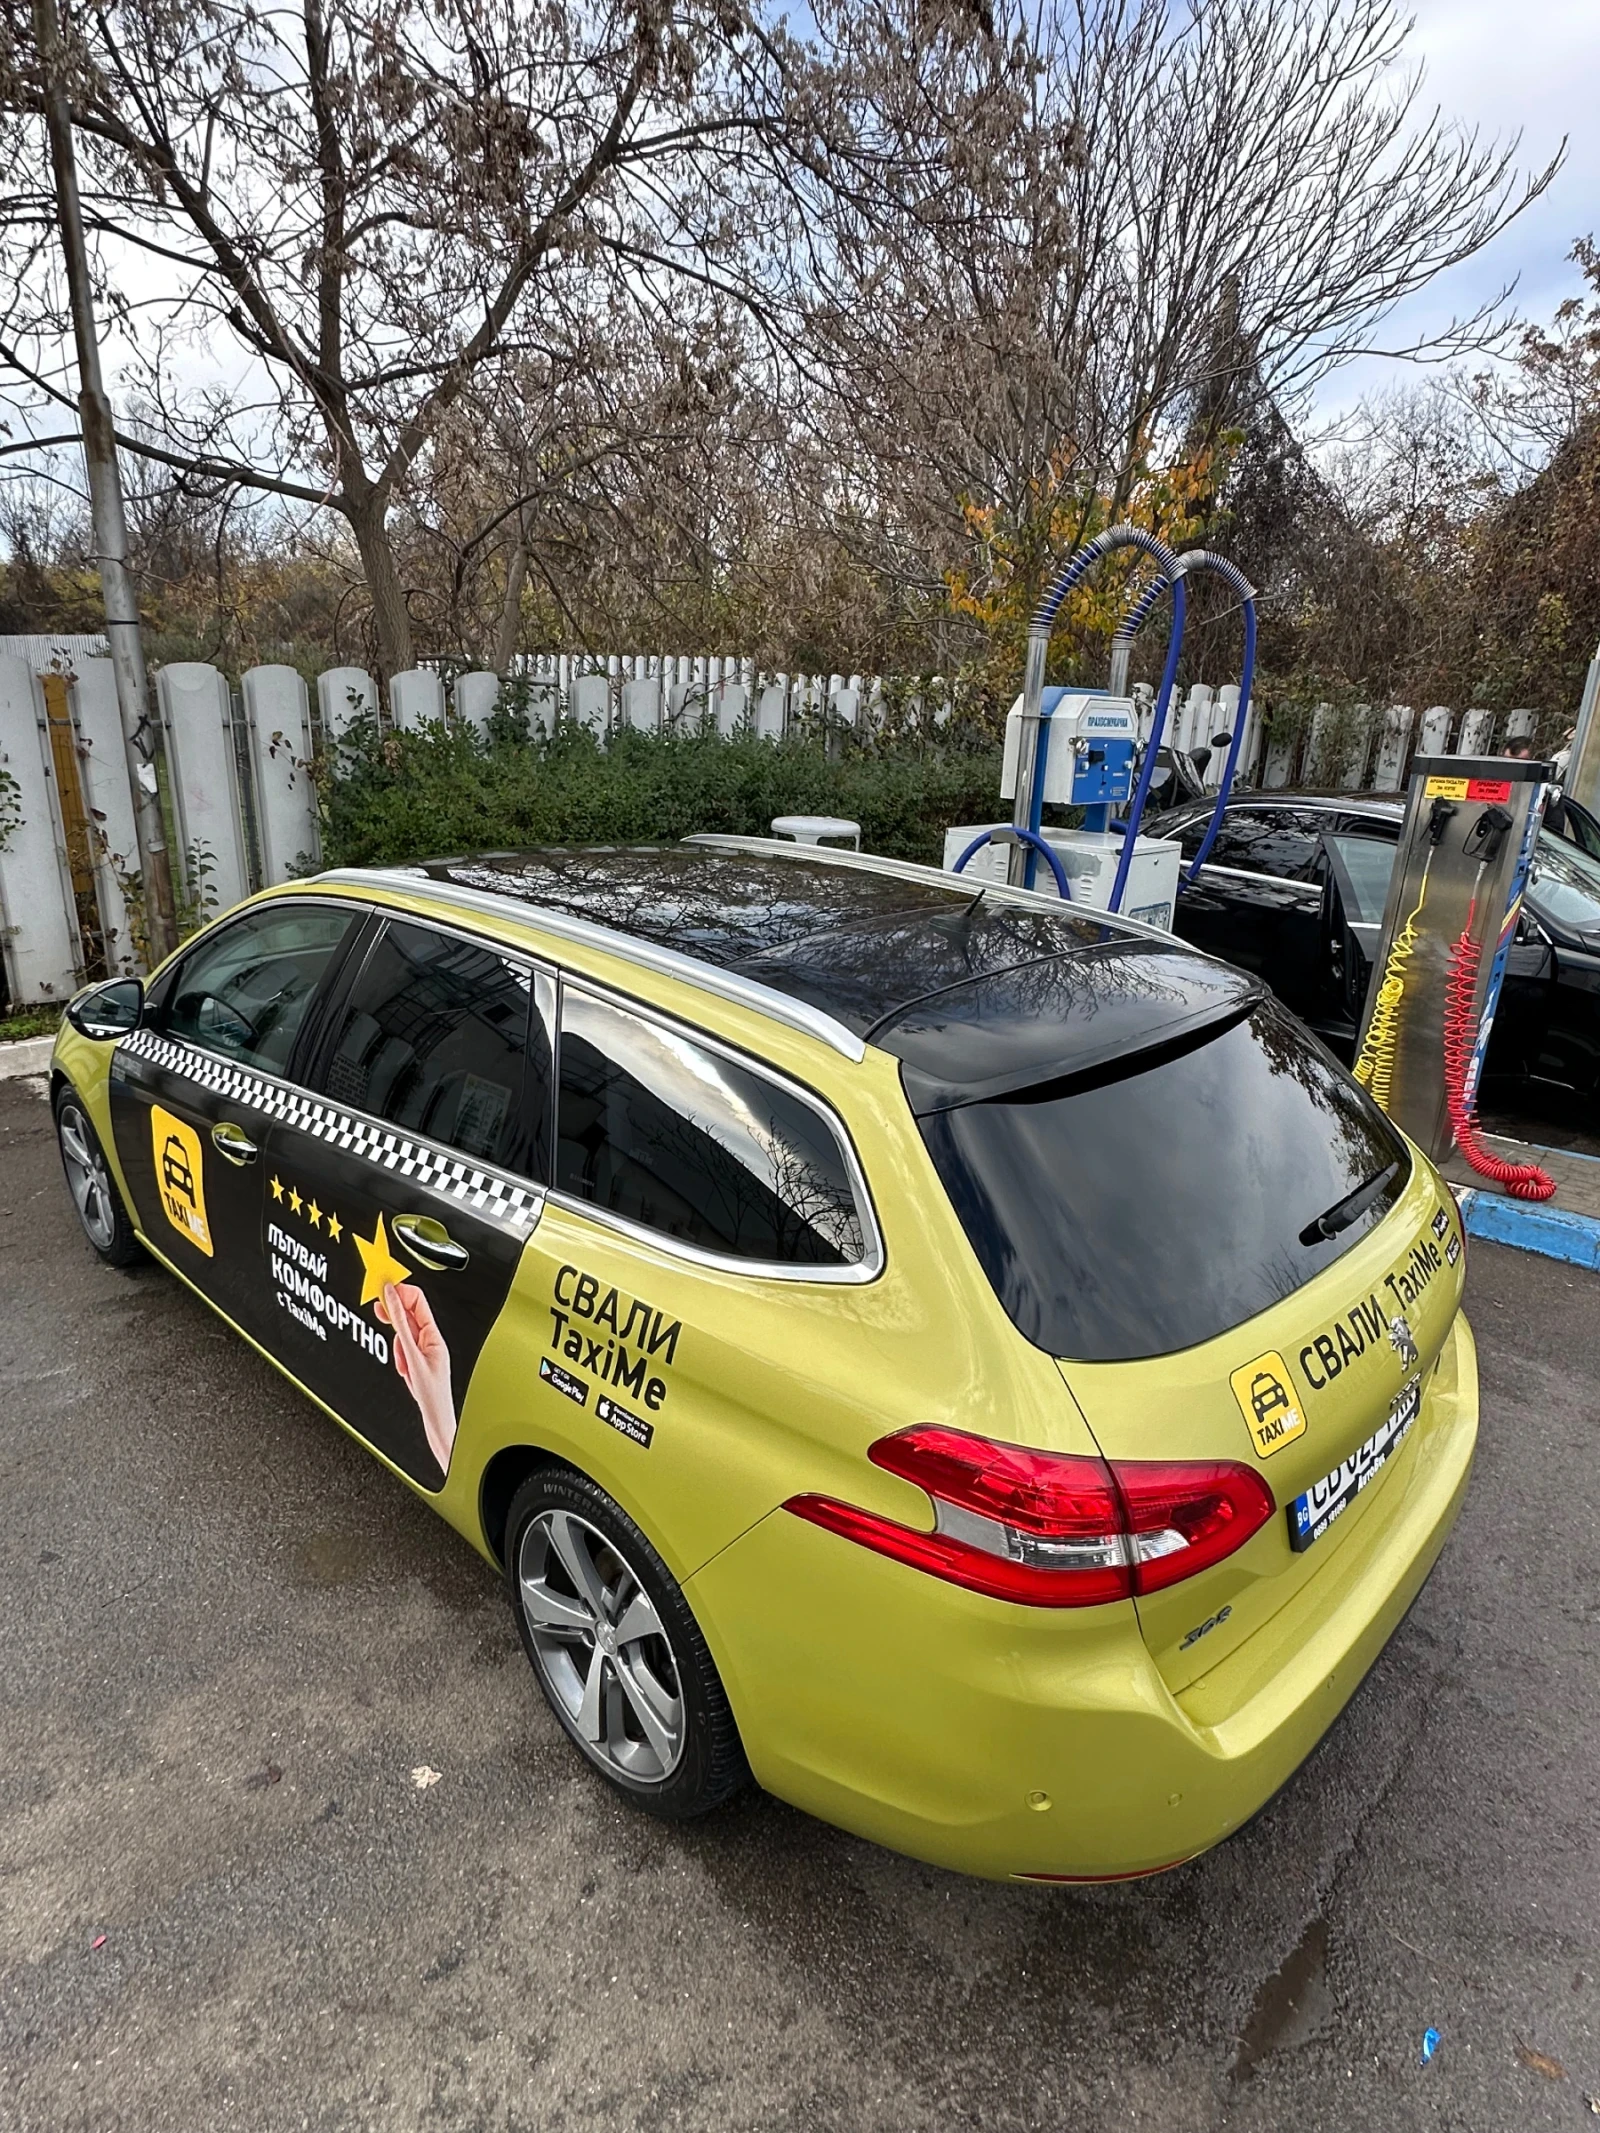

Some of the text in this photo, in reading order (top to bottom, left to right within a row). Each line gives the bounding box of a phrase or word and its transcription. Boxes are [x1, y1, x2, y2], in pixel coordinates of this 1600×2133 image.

[268, 1223, 328, 1283] ПЪТУВАЙ
[271, 1252, 389, 1365] КОМФОРТНО
[284, 1292, 328, 1342] TaxiMe
[554, 1264, 682, 1365] СВАЛИ
[1300, 1239, 1442, 1390] СВАЛИ TaxiMe
[550, 1306, 666, 1411] TaxiMe
[551, 1373, 585, 1403] Google Play
[610, 1413, 647, 1444] App Store
[1257, 1408, 1301, 1446] TAXIME
[1297, 1506, 1309, 1528] BG
